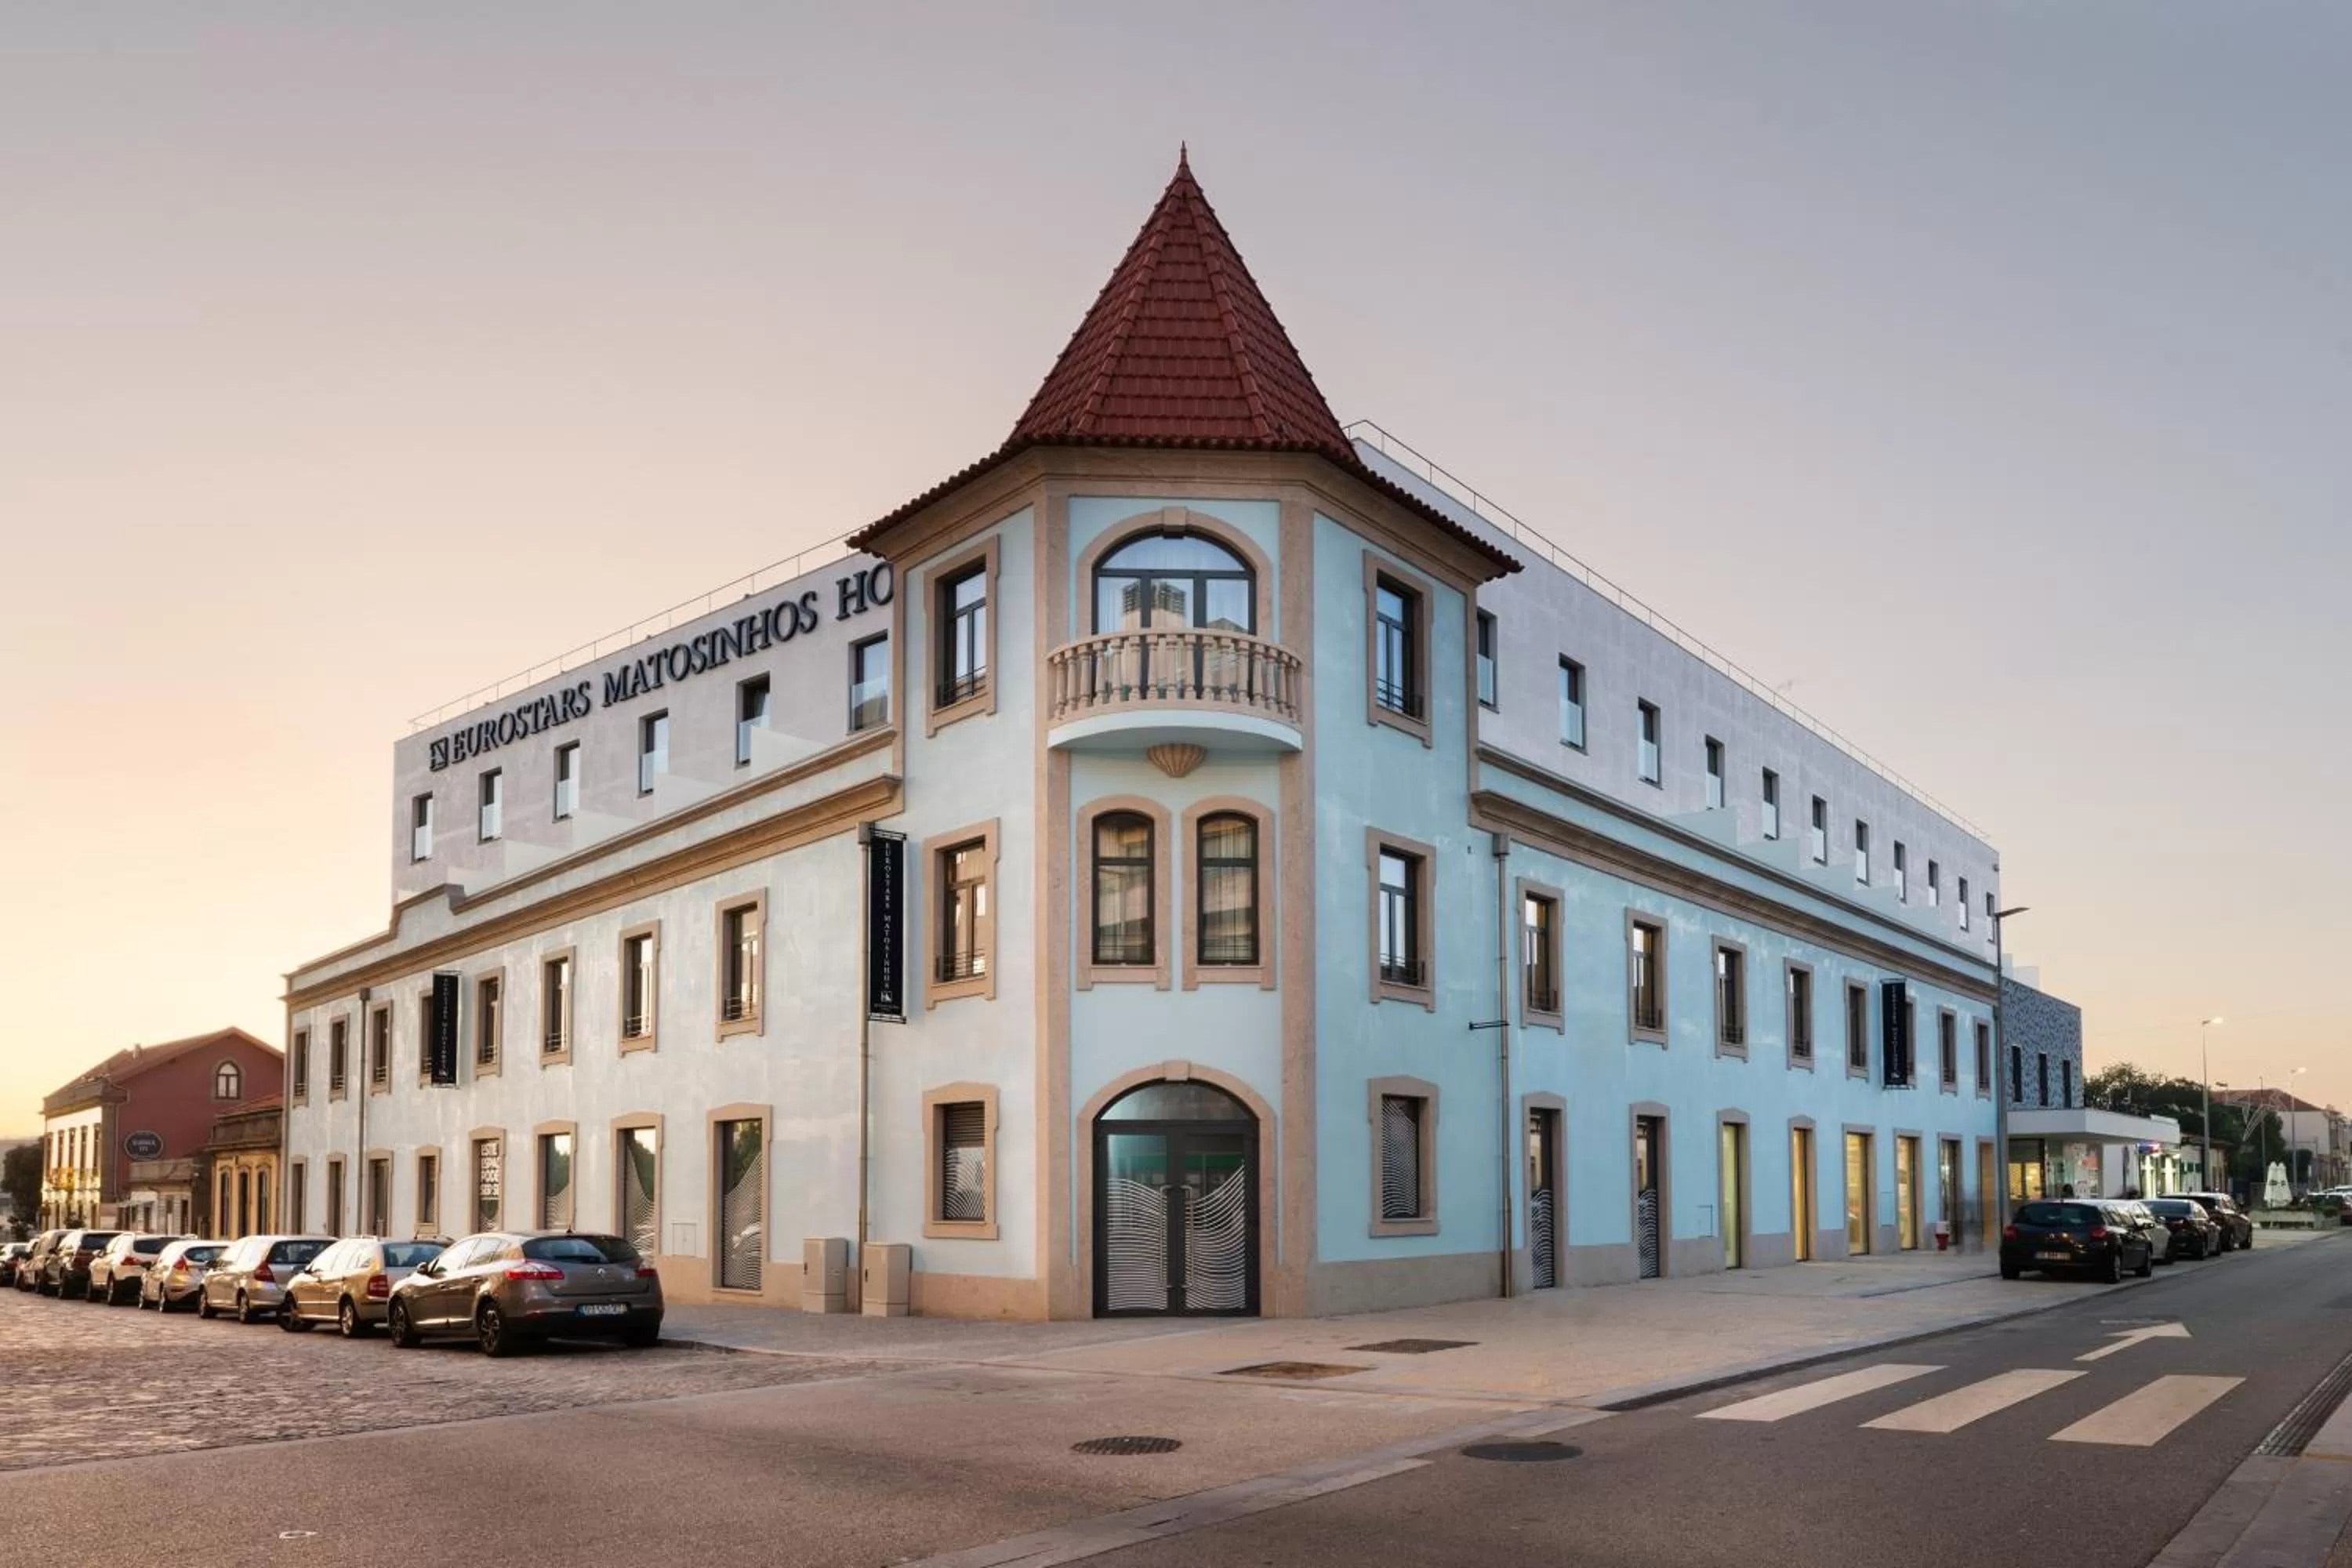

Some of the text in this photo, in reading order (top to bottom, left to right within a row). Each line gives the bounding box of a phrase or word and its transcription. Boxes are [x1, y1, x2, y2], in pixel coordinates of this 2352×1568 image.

[451, 561, 894, 764] EUROSTARS MATOSINHOS HO
